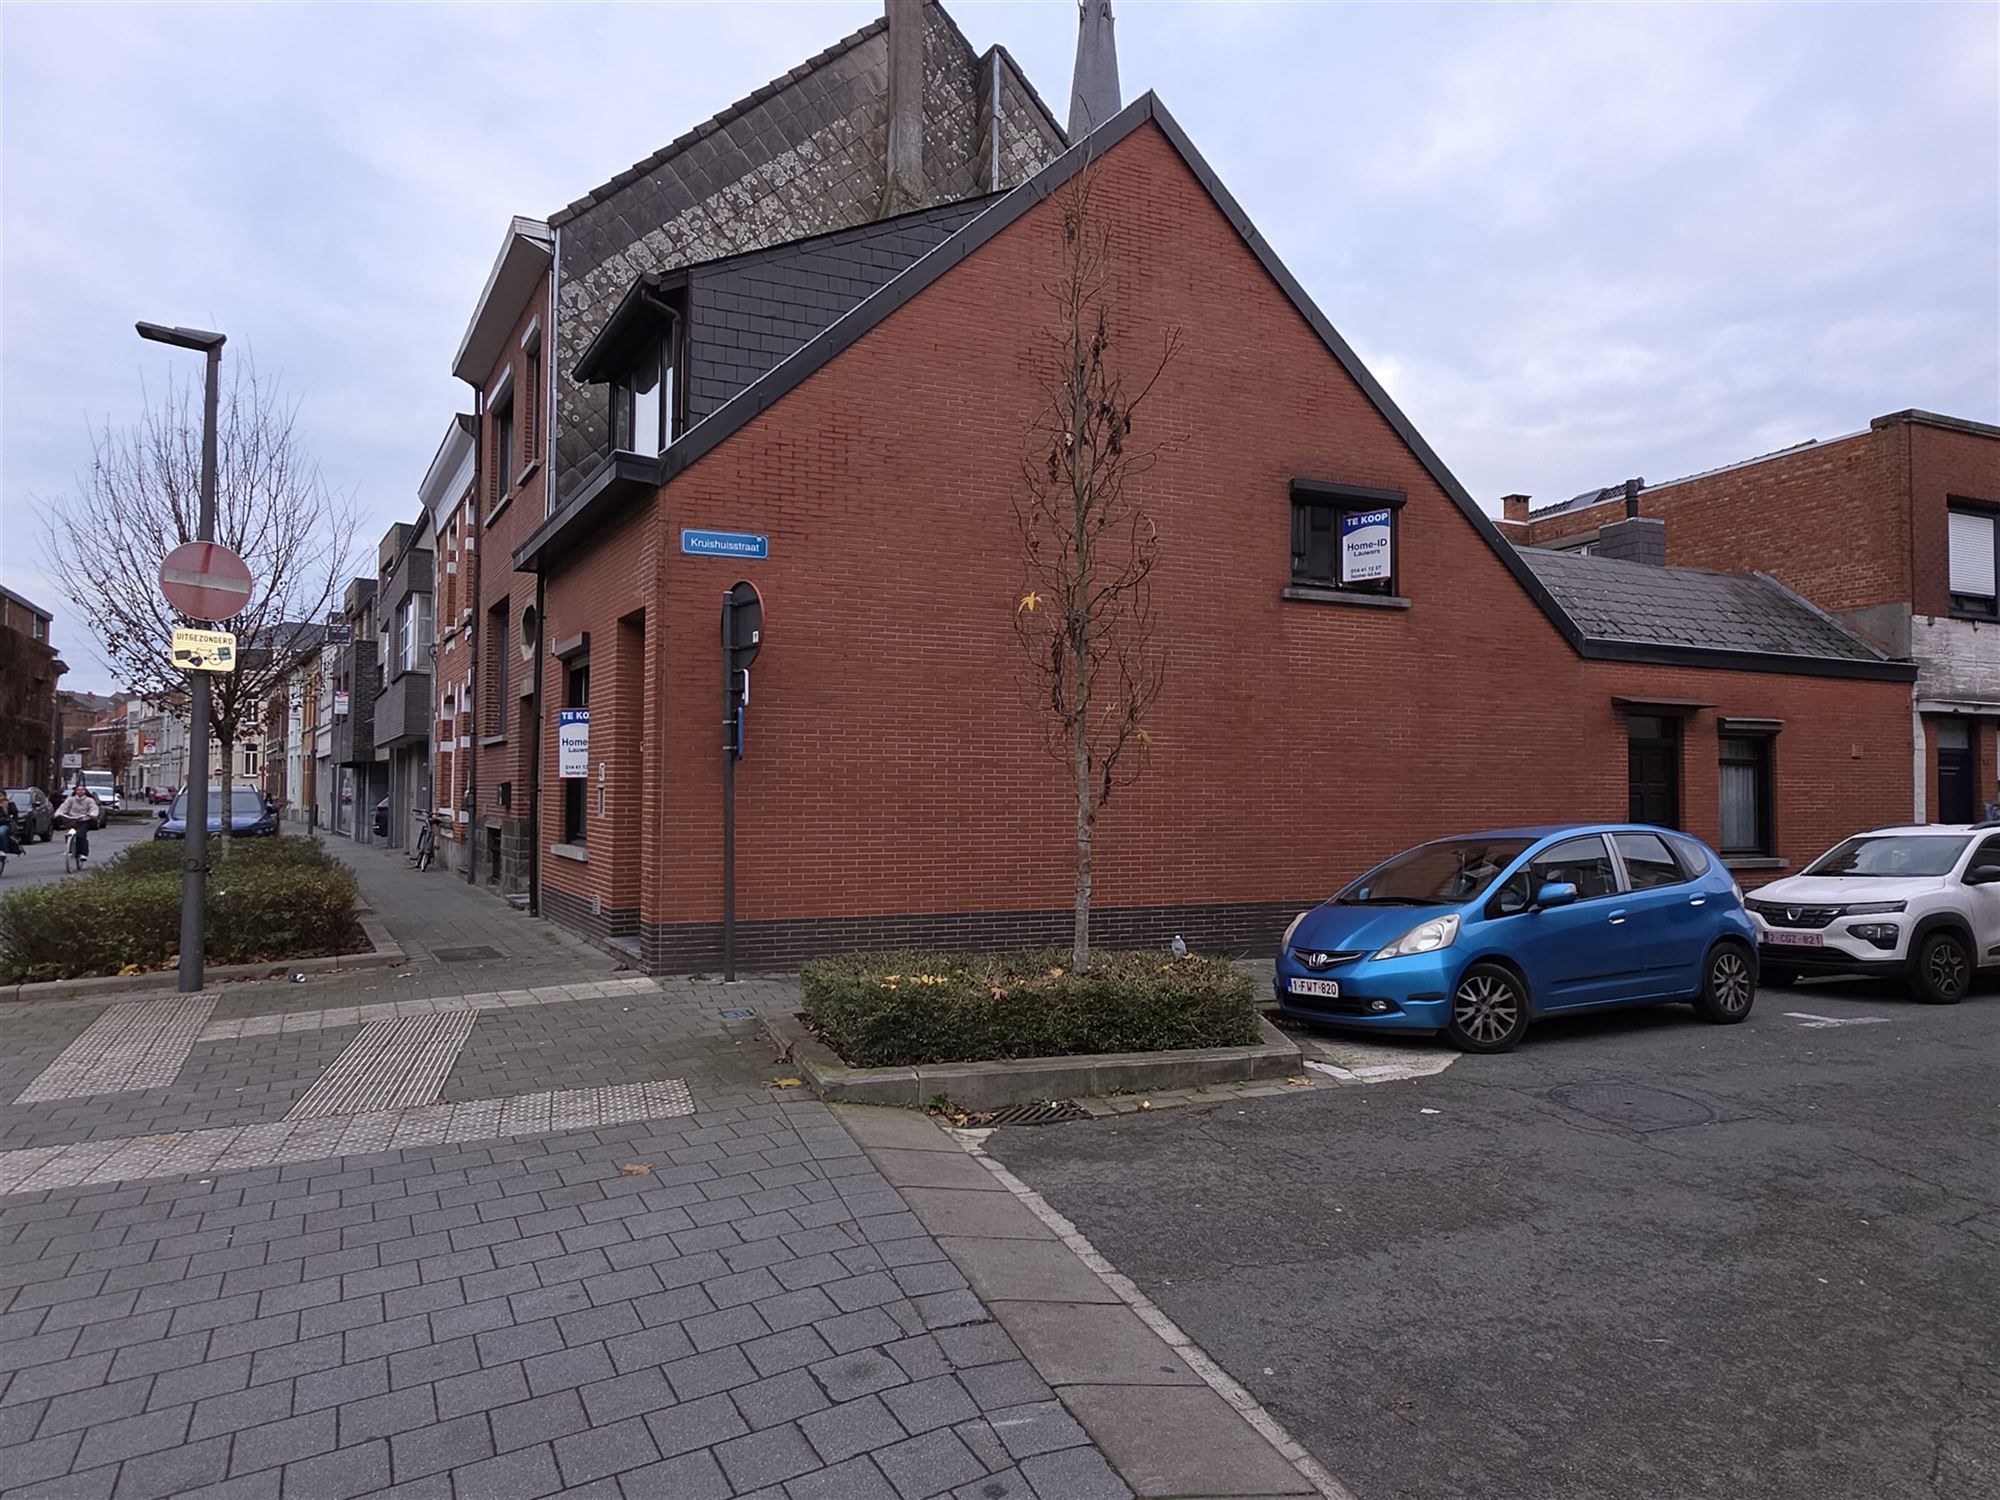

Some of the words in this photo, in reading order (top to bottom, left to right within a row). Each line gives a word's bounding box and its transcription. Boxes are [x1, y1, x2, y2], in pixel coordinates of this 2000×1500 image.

[1346, 517, 1358, 526] TE
[1361, 513, 1388, 524] KOOP
[691, 537, 760, 552] Kruishuisstraat
[1347, 538, 1387, 552] Home-ID
[176, 633, 234, 645] UITGEZONDERD
[561, 712, 573, 720] TE
[1293, 980, 1337, 995] 1-FWT-820
